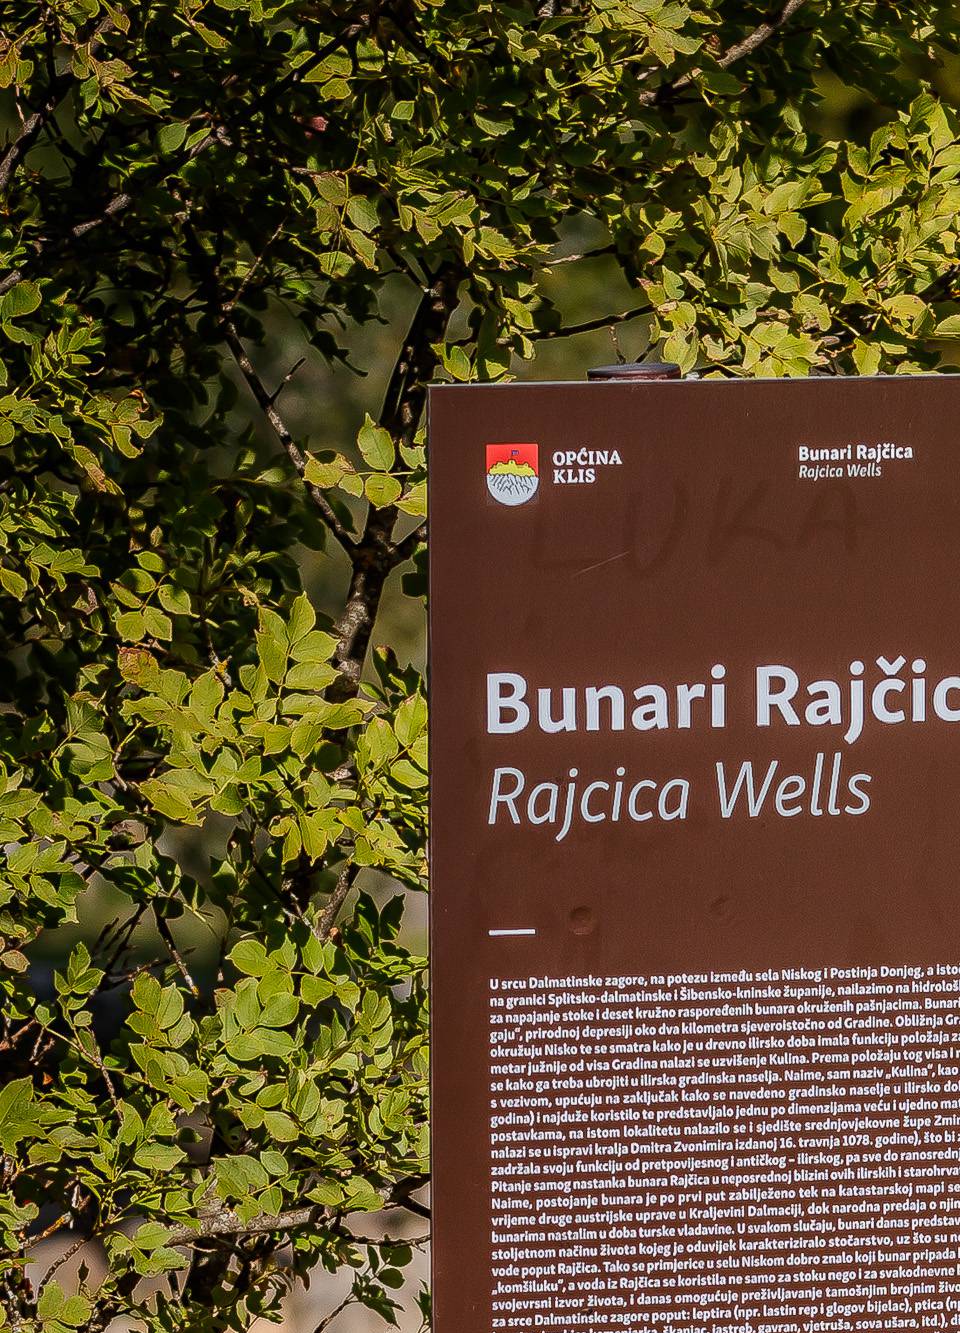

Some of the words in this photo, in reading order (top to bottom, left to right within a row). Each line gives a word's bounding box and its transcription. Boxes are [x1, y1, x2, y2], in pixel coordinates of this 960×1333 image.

[552, 446, 623, 467] OPĆINA
[798, 444, 852, 462] Bunari
[856, 443, 914, 465] Rajčica
[553, 468, 596, 484] KLIS
[798, 464, 844, 481] Rajcica
[847, 463, 882, 478] Wells
[486, 663, 726, 734] Bunari
[487, 766, 690, 842] Rajcica
[715, 751, 872, 819] Wells
[489, 978, 498, 989] U
[501, 980, 526, 989] srcu
[529, 974, 602, 988] Dalmatinske
[604, 976, 647, 988] zagore,
[650, 975, 664, 984] na
[666, 973, 707, 987] potezu
[710, 969, 752, 982] između
[755, 968, 779, 981] sela
[781, 967, 821, 982] Niskog
[823, 967, 827, 978] i
[830, 966, 877, 980] Postinja
[880, 964, 924, 979] Donjeg,
[926, 966, 933, 975] a
[491, 1180, 531, 1194] Pitanje
[533, 1180, 571, 1193] samog
[572, 1175, 625, 1189] nastanka
[627, 1175, 667, 1187] bunara
[670, 1173, 709, 1188] Rajčica
[711, 1175, 719, 1184] u
[721, 1170, 791, 1186] neposrednoj
[793, 1168, 828, 1181] blizini
[830, 1167, 854, 1180] ovih
[856, 1165, 896, 1178] ilirskih
[898, 1166, 901, 1177] i
[492, 1296, 551, 1312] svojevrsni
[554, 1296, 584, 1307] izvor
[587, 1294, 627, 1307] života,
[629, 1293, 634, 1304] i
[636, 1292, 671, 1304] danas
[674, 1289, 738, 1305] omogućuje
[741, 1286, 822, 1303] preživljavanje
[825, 1284, 886, 1298] tamošnjim
[890, 1282, 935, 1297] brojnim
